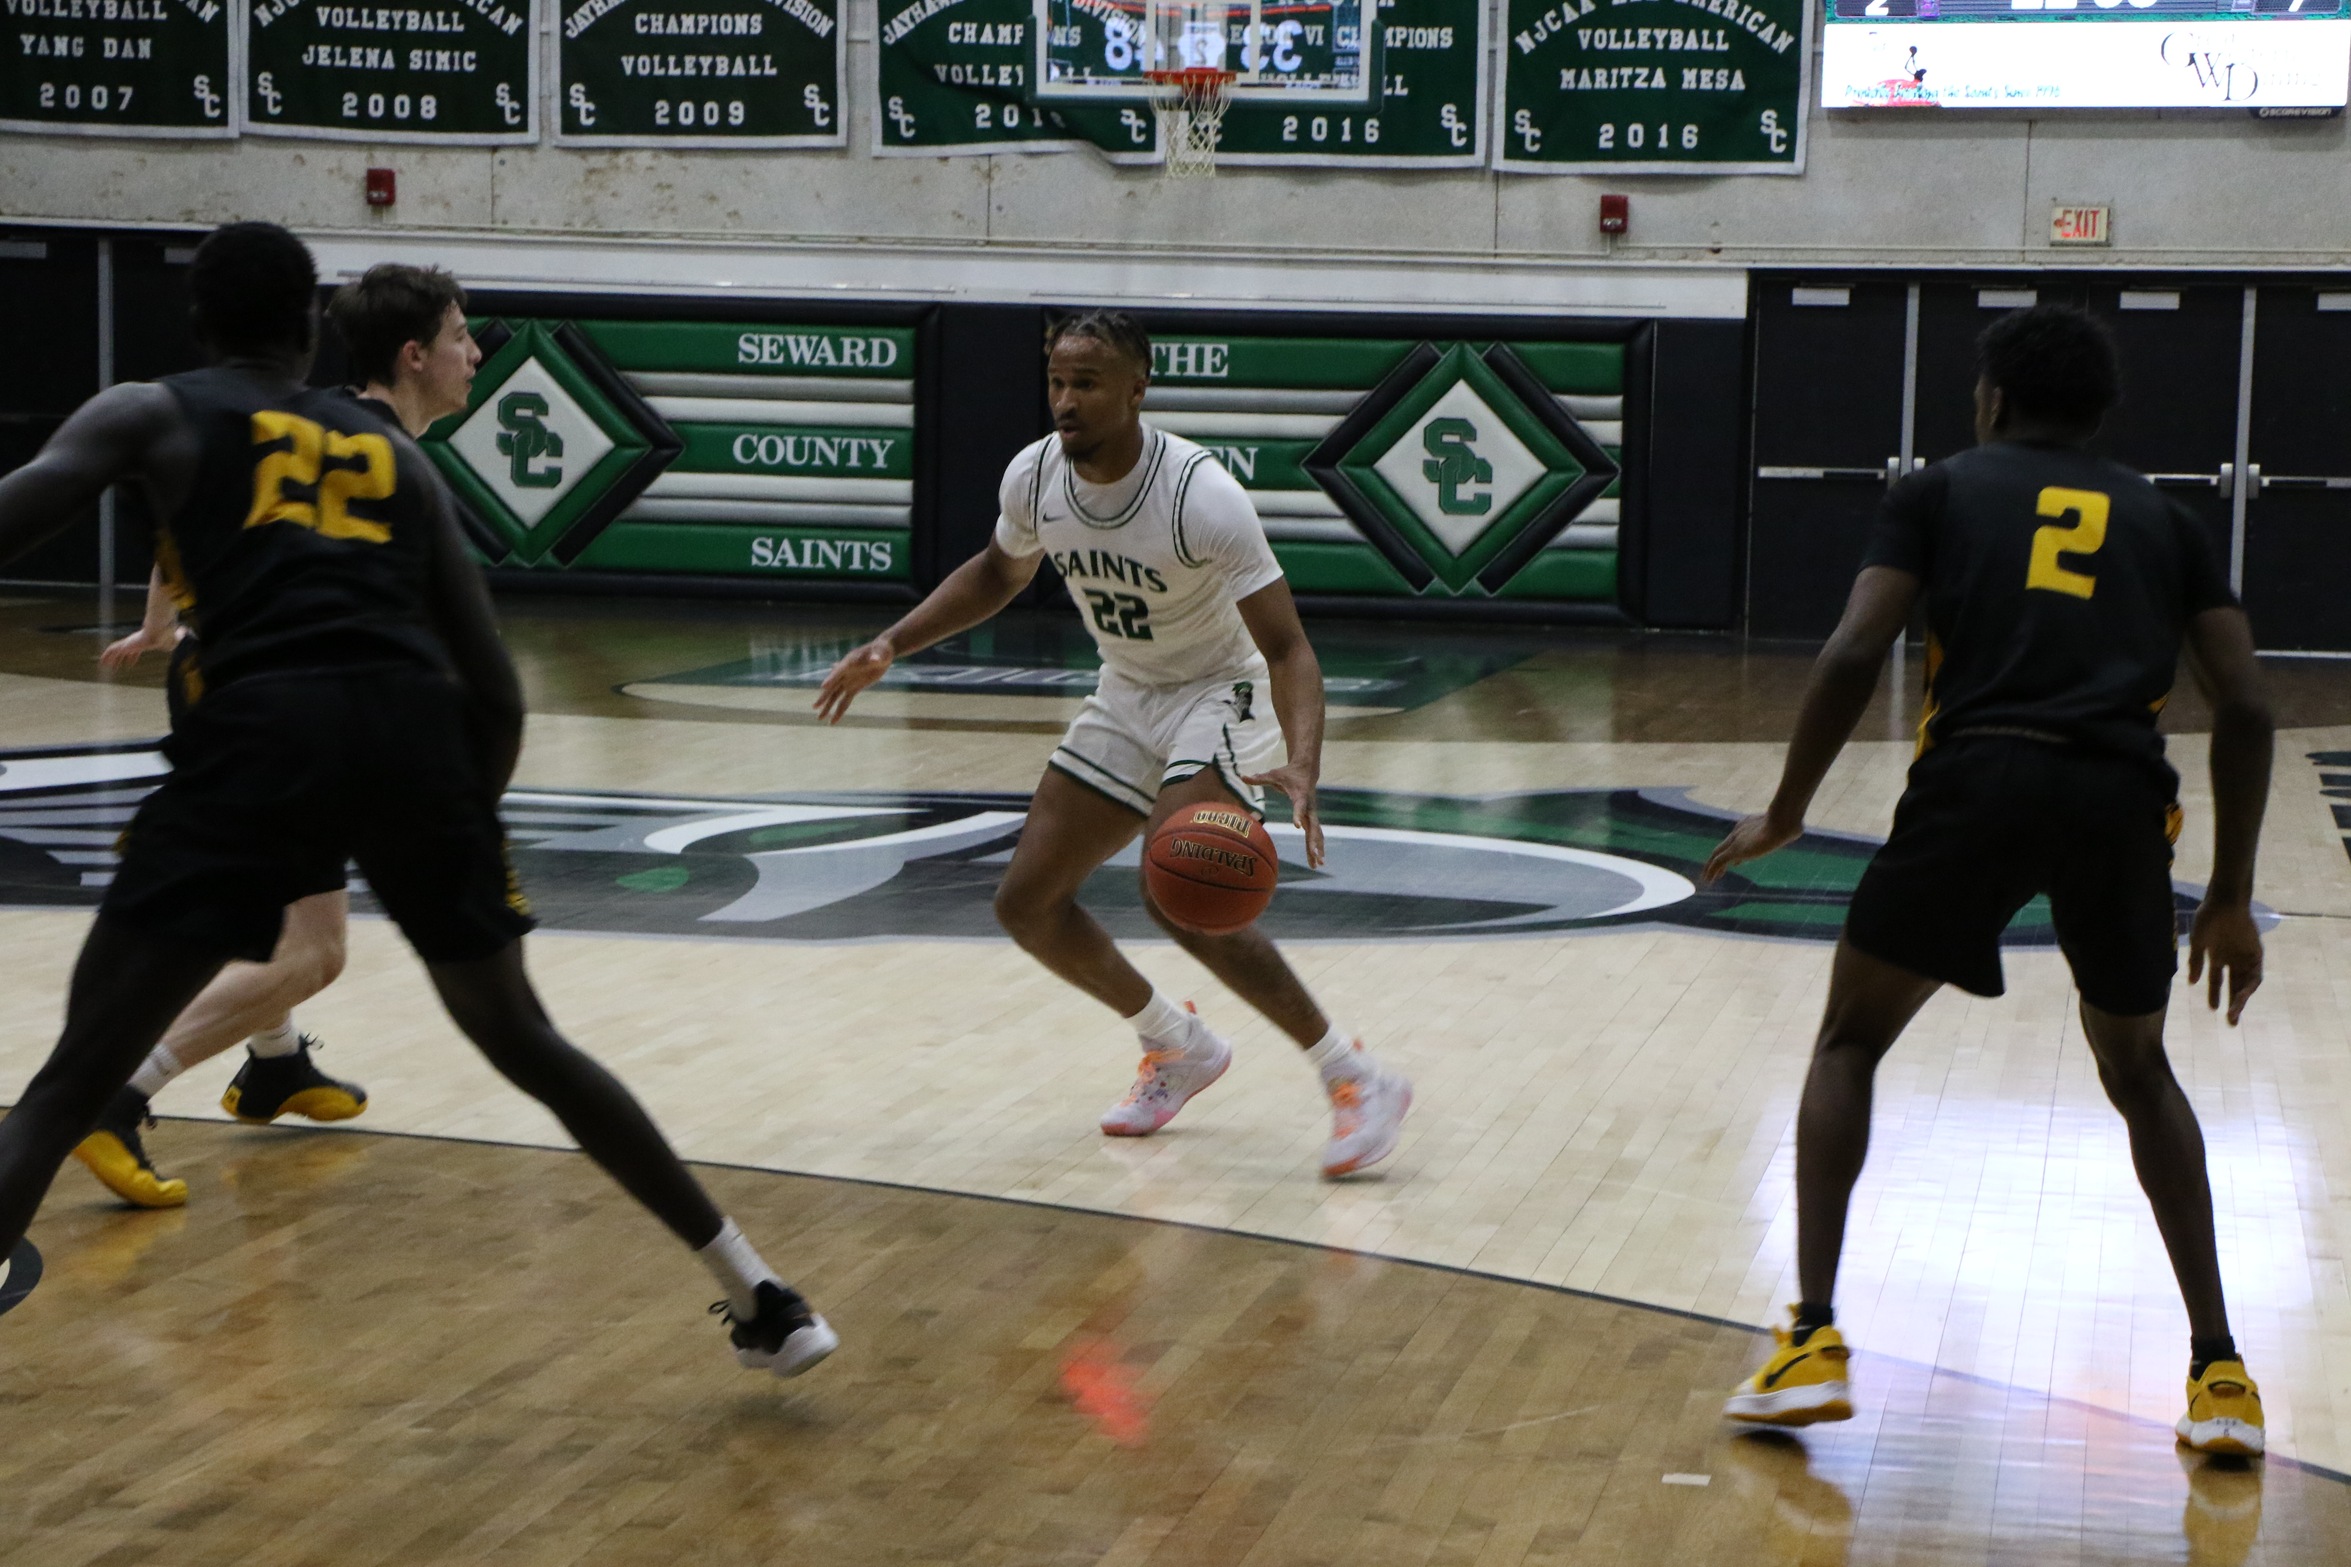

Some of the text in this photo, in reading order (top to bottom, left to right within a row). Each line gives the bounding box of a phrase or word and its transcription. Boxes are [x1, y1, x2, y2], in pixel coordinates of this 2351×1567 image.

[6, 0, 168, 20] VOLLEYBALL
[316, 7, 465, 33] VOLLEYBALL
[634, 13, 763, 35] CHAMPIONS
[20, 34, 153, 59] YANG DAN
[1578, 28, 1729, 51] VOLLEYBALL
[302, 45, 477, 72] JELENA SIMIC
[621, 55, 778, 77] VOLLEYBALL
[1560, 68, 1746, 91] MARITZA MESA
[40, 83, 134, 110] 2007
[342, 92, 438, 119] 2008
[655, 101, 745, 125] 2009
[1283, 117, 1380, 144] 2016
[1599, 123, 1698, 149] 2016
[2061, 209, 2101, 239] EXIT
[738, 333, 897, 367] SEWARD
[1150, 342, 1229, 378] THE
[496, 391, 564, 488] SC
[733, 433, 894, 469] COUNTY
[243, 409, 398, 545] 22
[1423, 417, 1493, 515] SC
[751, 537, 892, 571] SAINTS
[2026, 486, 2112, 600] 2
[1052, 549, 1168, 593] SAINTS
[1082, 585, 1154, 641] 22
[1169, 837, 1258, 877] SPALDING
